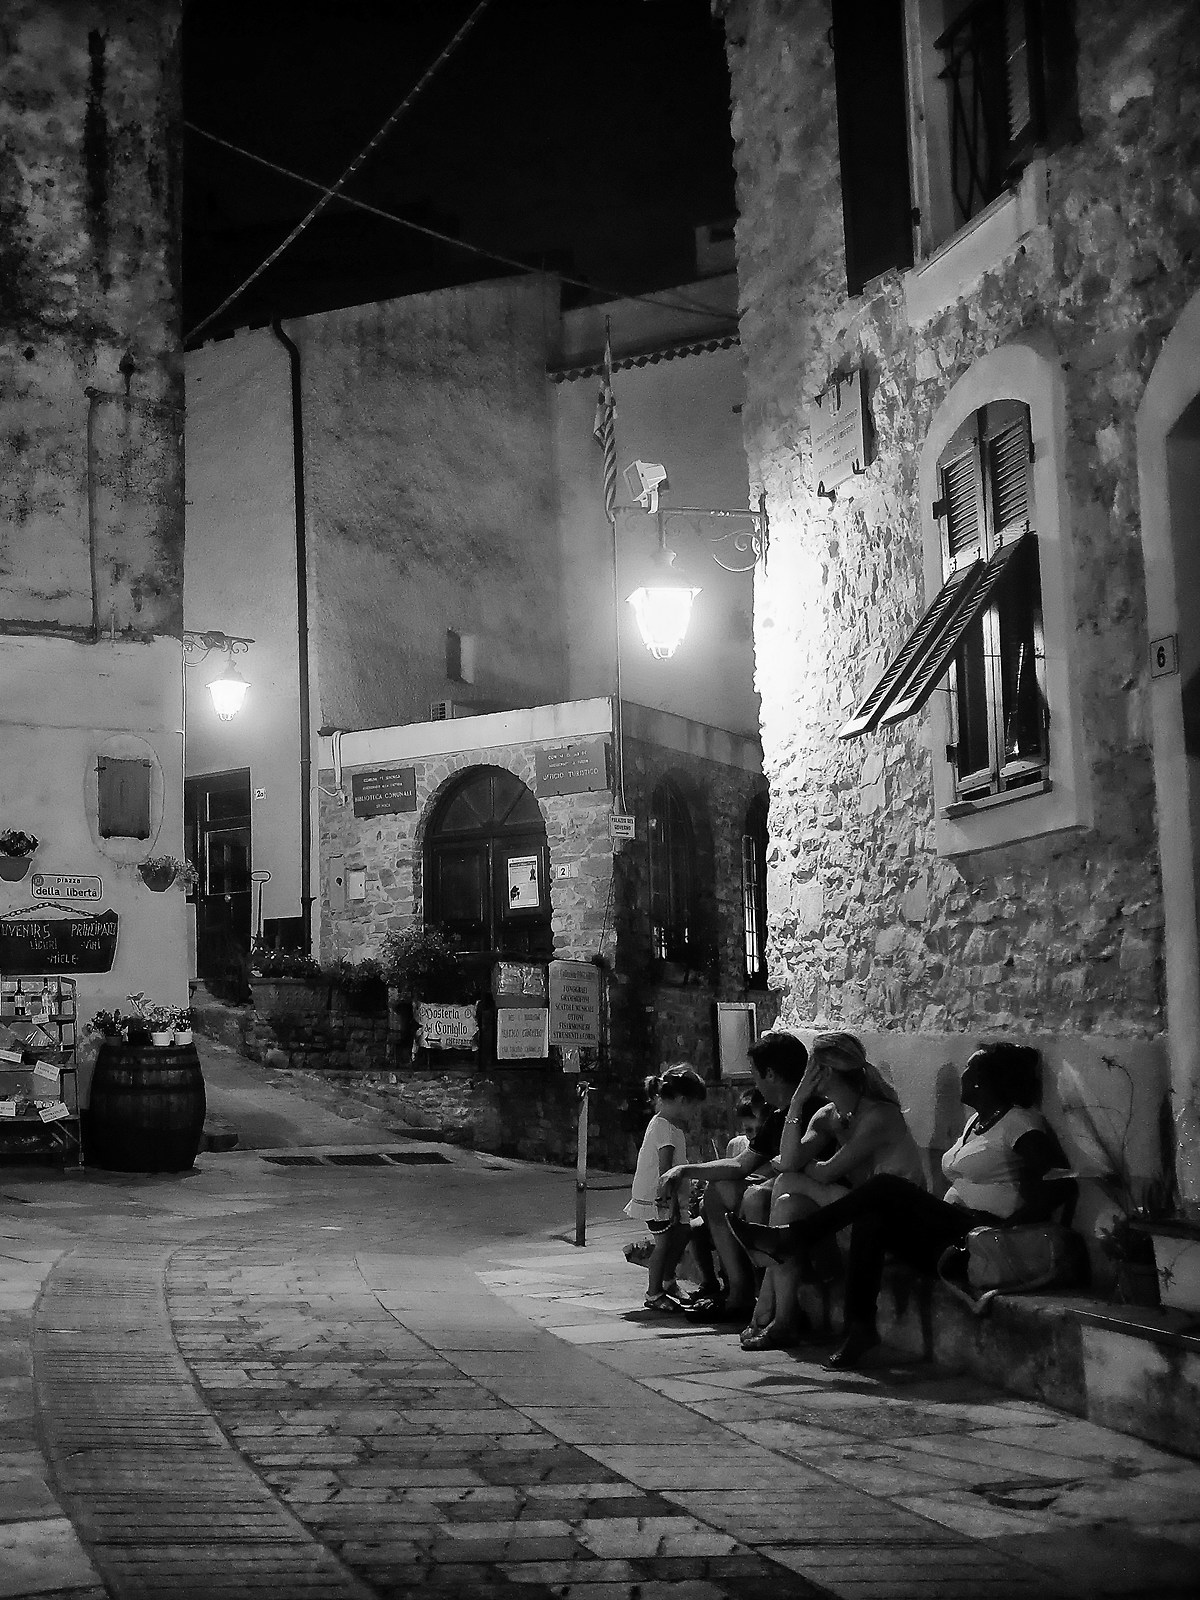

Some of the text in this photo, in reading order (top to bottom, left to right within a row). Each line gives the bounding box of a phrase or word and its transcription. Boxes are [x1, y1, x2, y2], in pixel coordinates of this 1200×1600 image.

[1156, 645, 1166, 668] 6
[560, 867, 566, 876] 2
[35, 886, 60, 896] della
